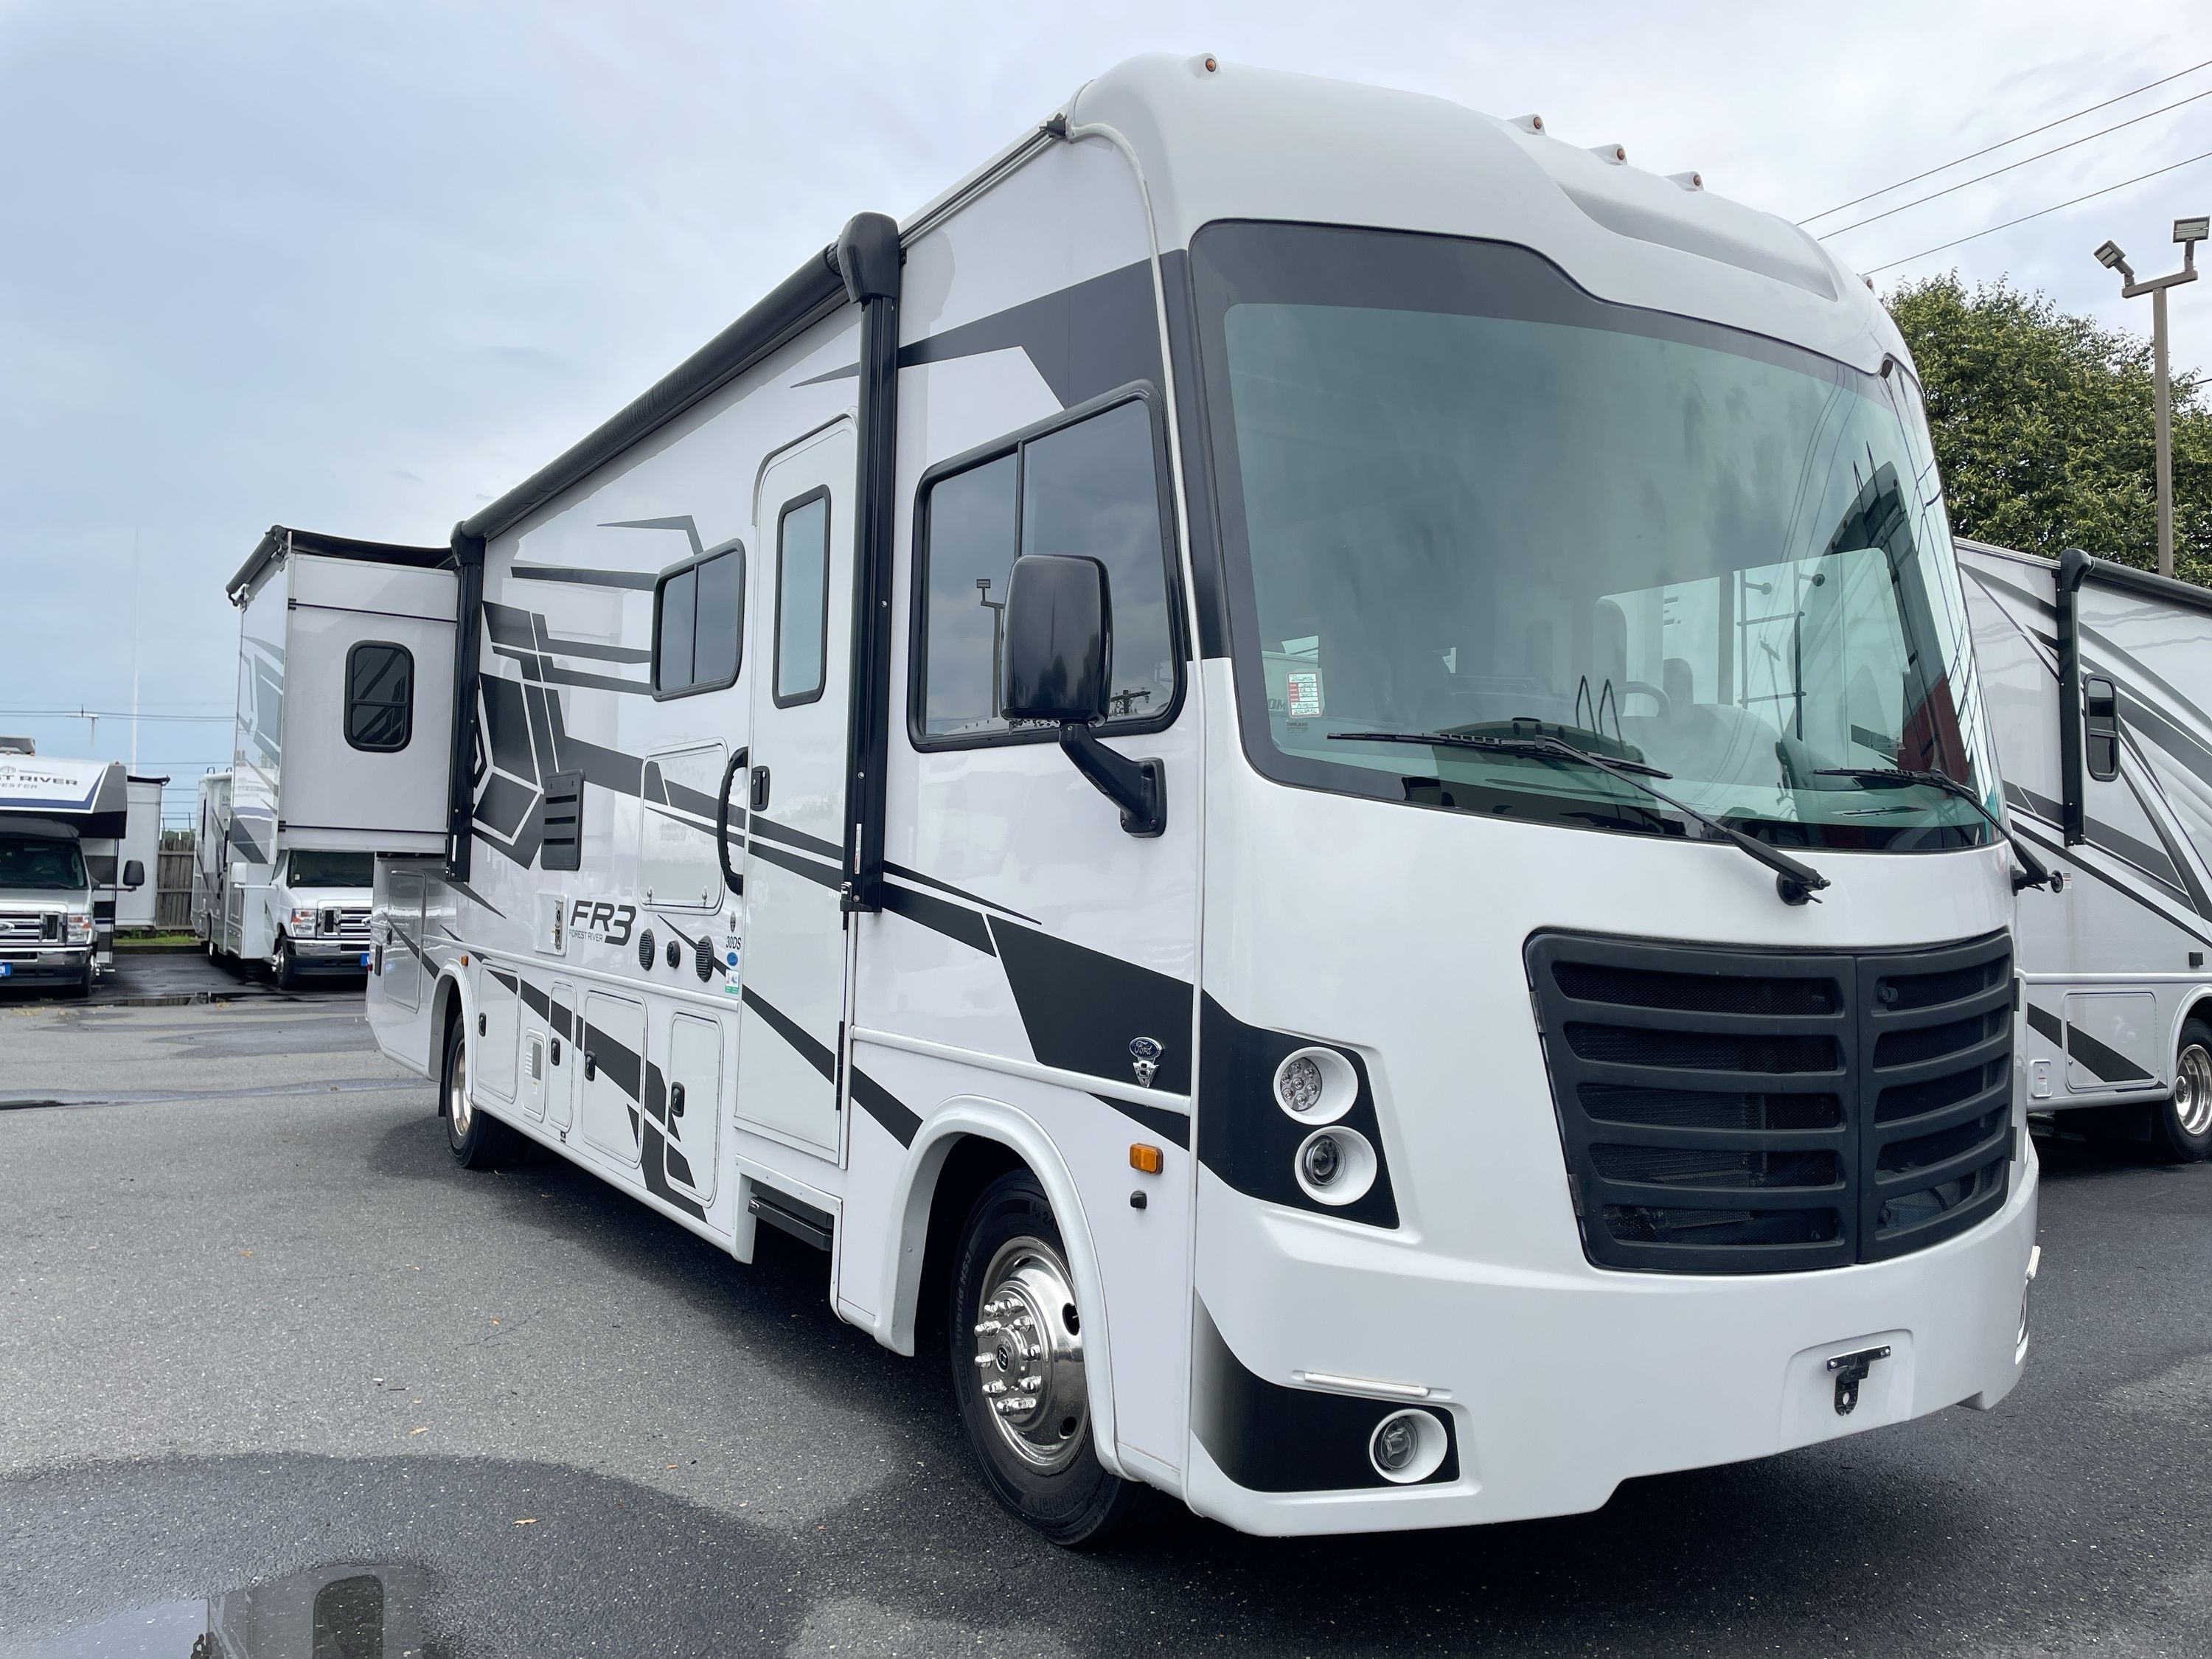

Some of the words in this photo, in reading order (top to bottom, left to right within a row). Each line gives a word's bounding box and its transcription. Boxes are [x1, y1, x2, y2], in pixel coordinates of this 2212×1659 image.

[20, 776, 77, 785] RIVER
[570, 900, 636, 947] FR3
[568, 929, 588, 939] FOREST
[587, 932, 603, 942] RIVER
[726, 936, 742, 950] 30DS
[1134, 1040, 1152, 1055] Ford
